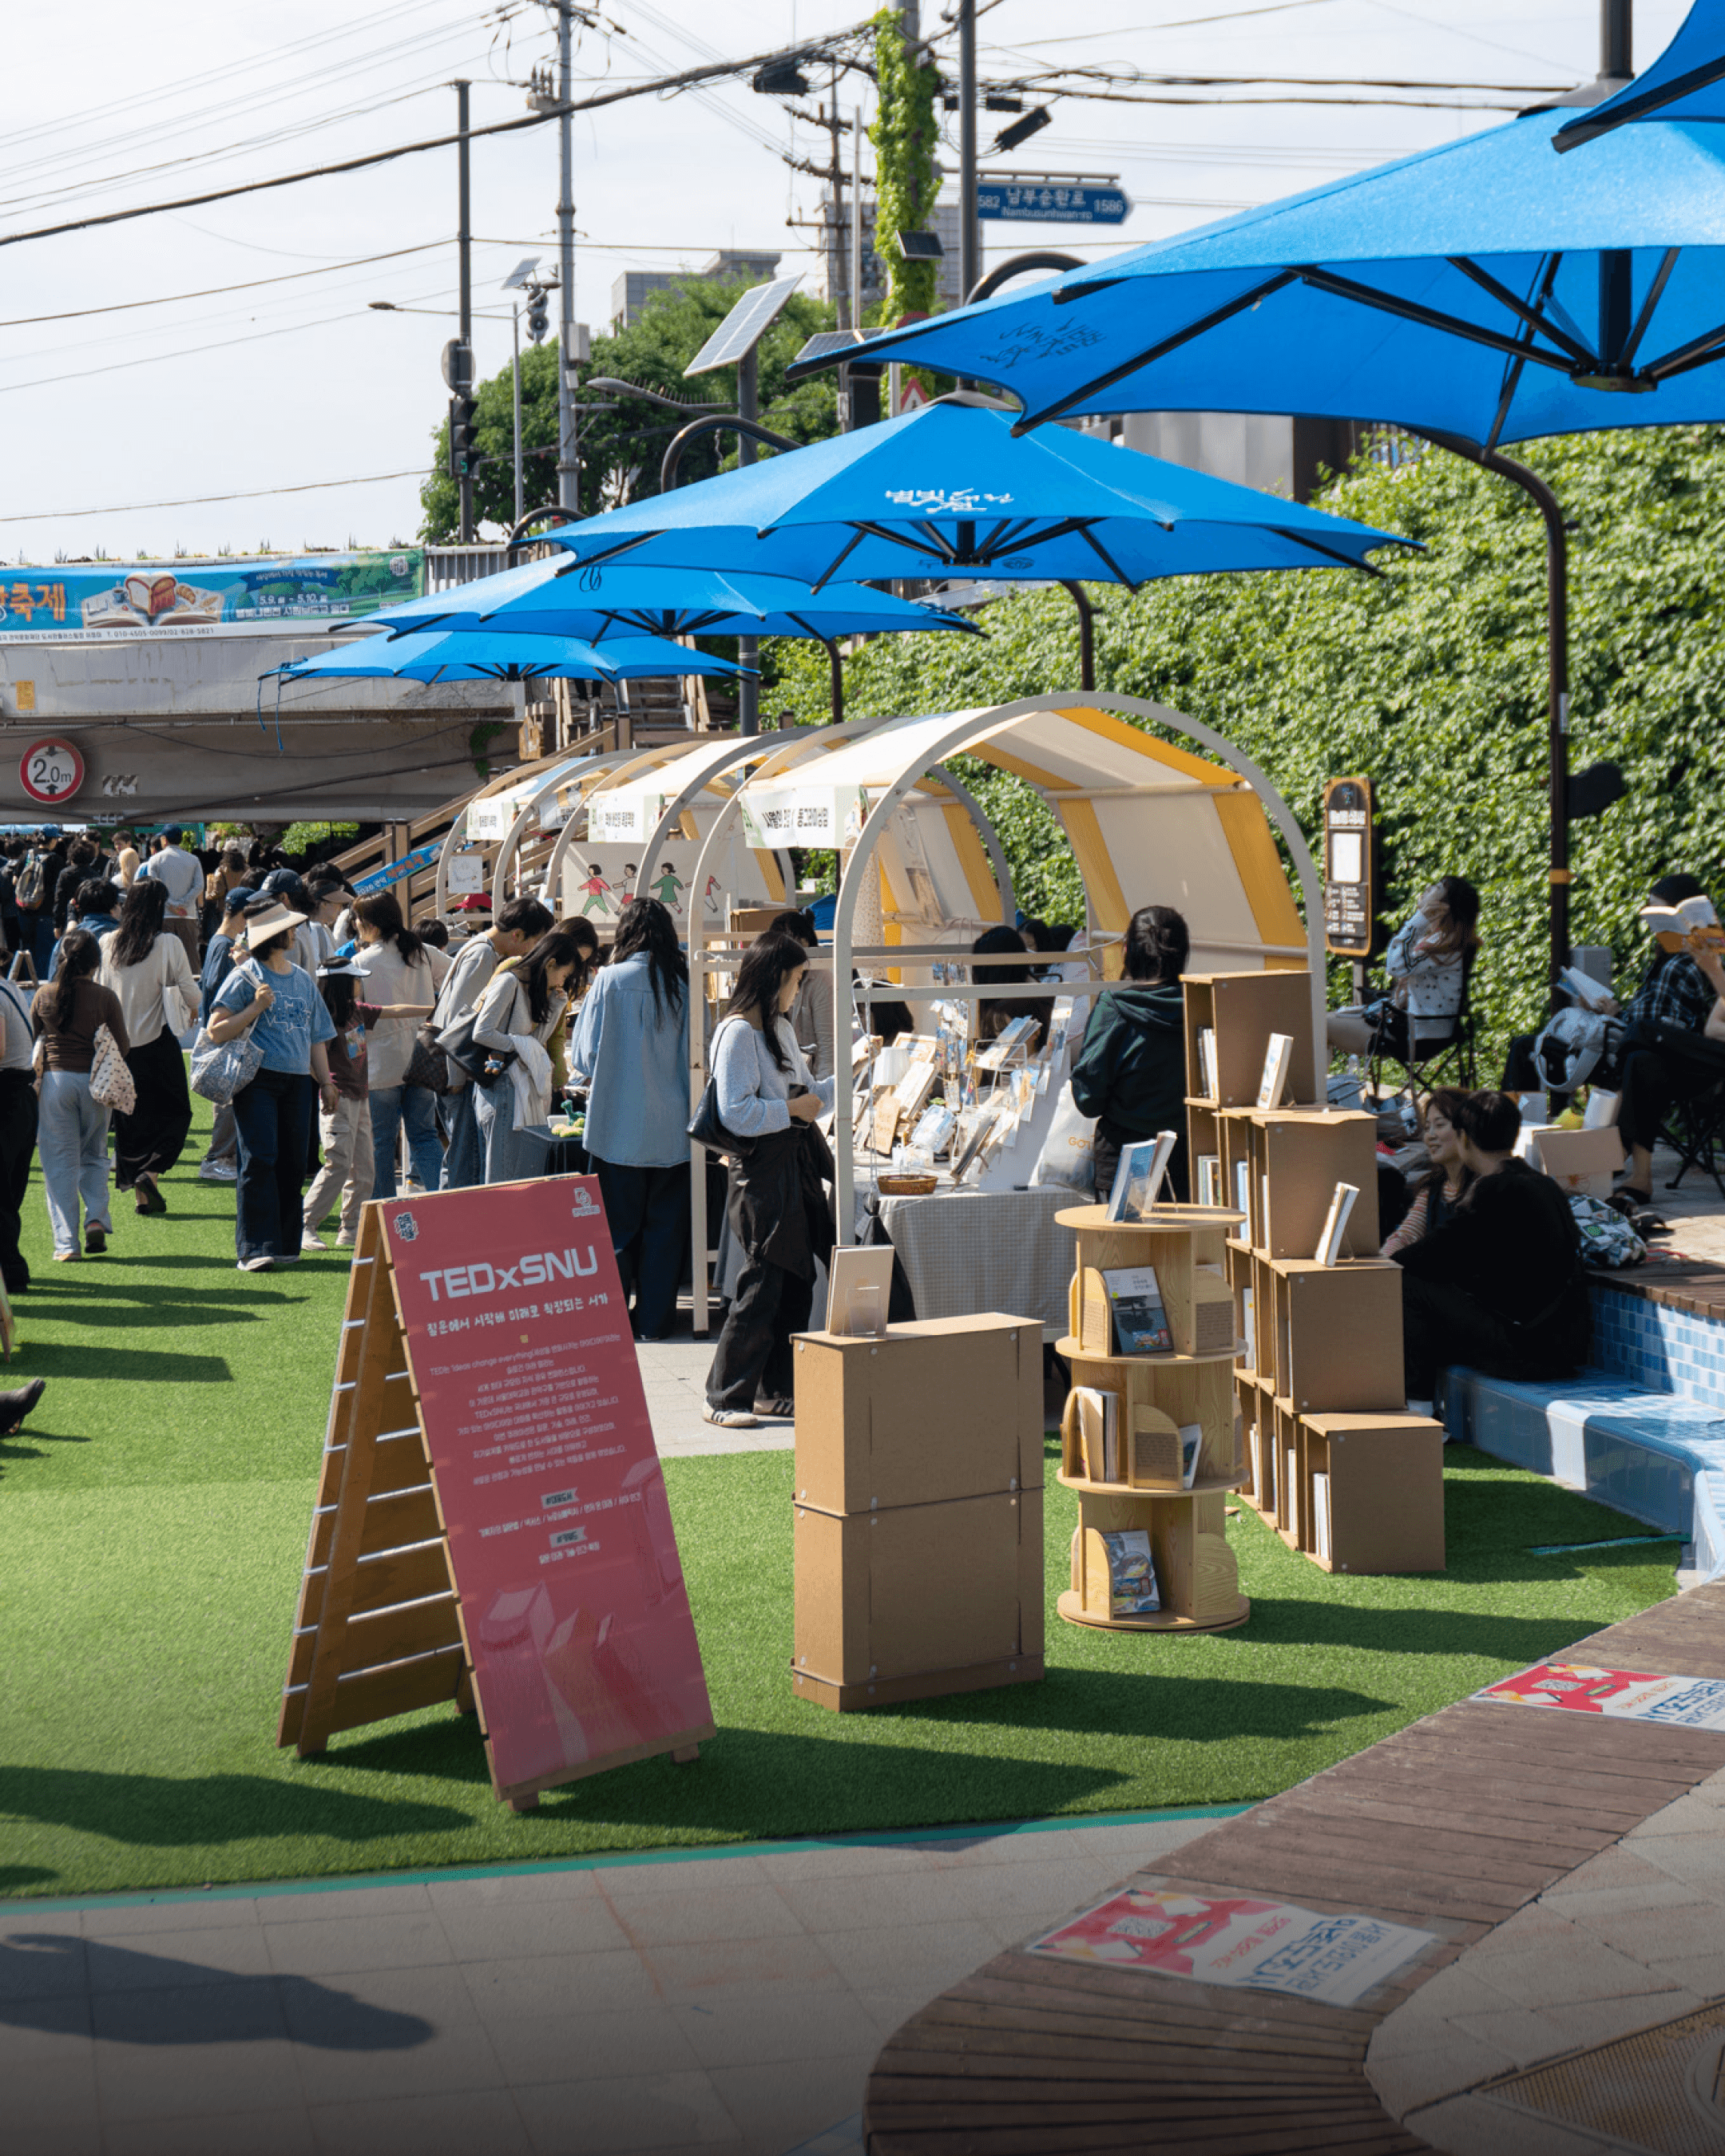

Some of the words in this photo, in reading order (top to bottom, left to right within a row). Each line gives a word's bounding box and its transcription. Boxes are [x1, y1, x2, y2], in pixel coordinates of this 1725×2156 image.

[978, 195, 1000, 208] 582
[1005, 187, 1086, 208] 남부순환로
[1094, 199, 1123, 213] 1586
[1001, 207, 1092, 220] Nambusunhwan-ro
[0, 582, 65, 621] 축제
[33, 756, 71, 784] 2.0m
[419, 1246, 597, 1300] TEDxSNU
[474, 1311, 506, 1326] 시작해
[508, 1304, 540, 1321] 미래로
[543, 1297, 583, 1314] 확장되는
[588, 1292, 608, 1306] 서가
